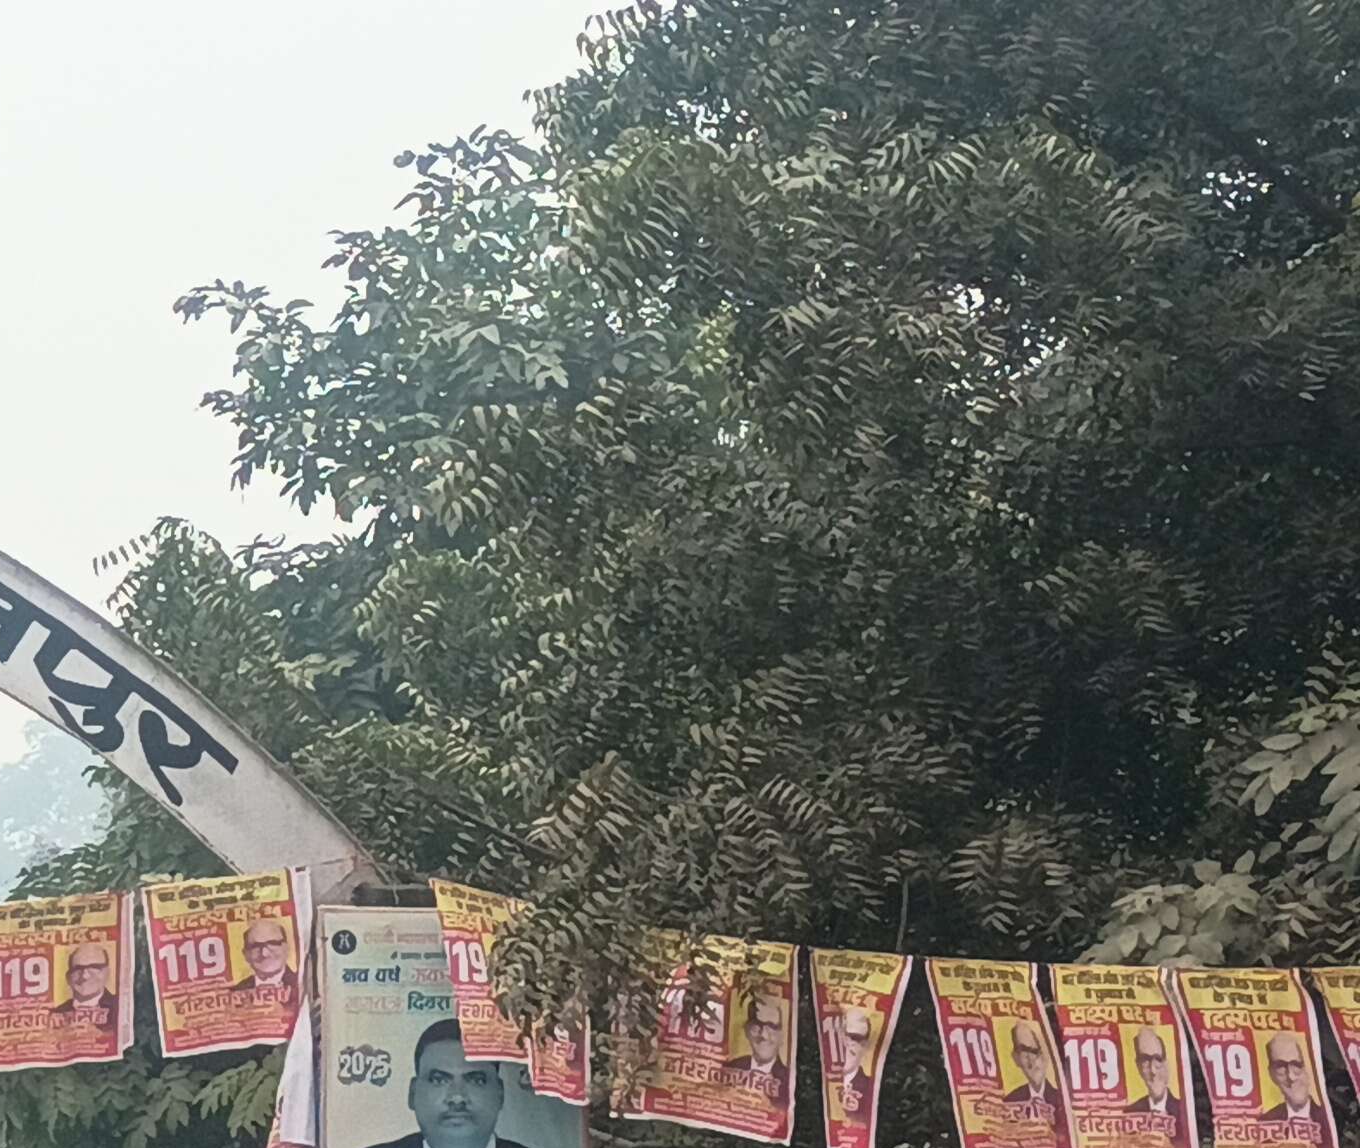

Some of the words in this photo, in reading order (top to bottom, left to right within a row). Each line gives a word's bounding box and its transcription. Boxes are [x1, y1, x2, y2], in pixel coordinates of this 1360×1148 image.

[158, 936, 226, 983] 119
[443, 939, 490, 984] 19
[949, 1027, 998, 1078] 119
[1064, 1038, 1120, 1090] 119
[1204, 1044, 1254, 1097] 19
